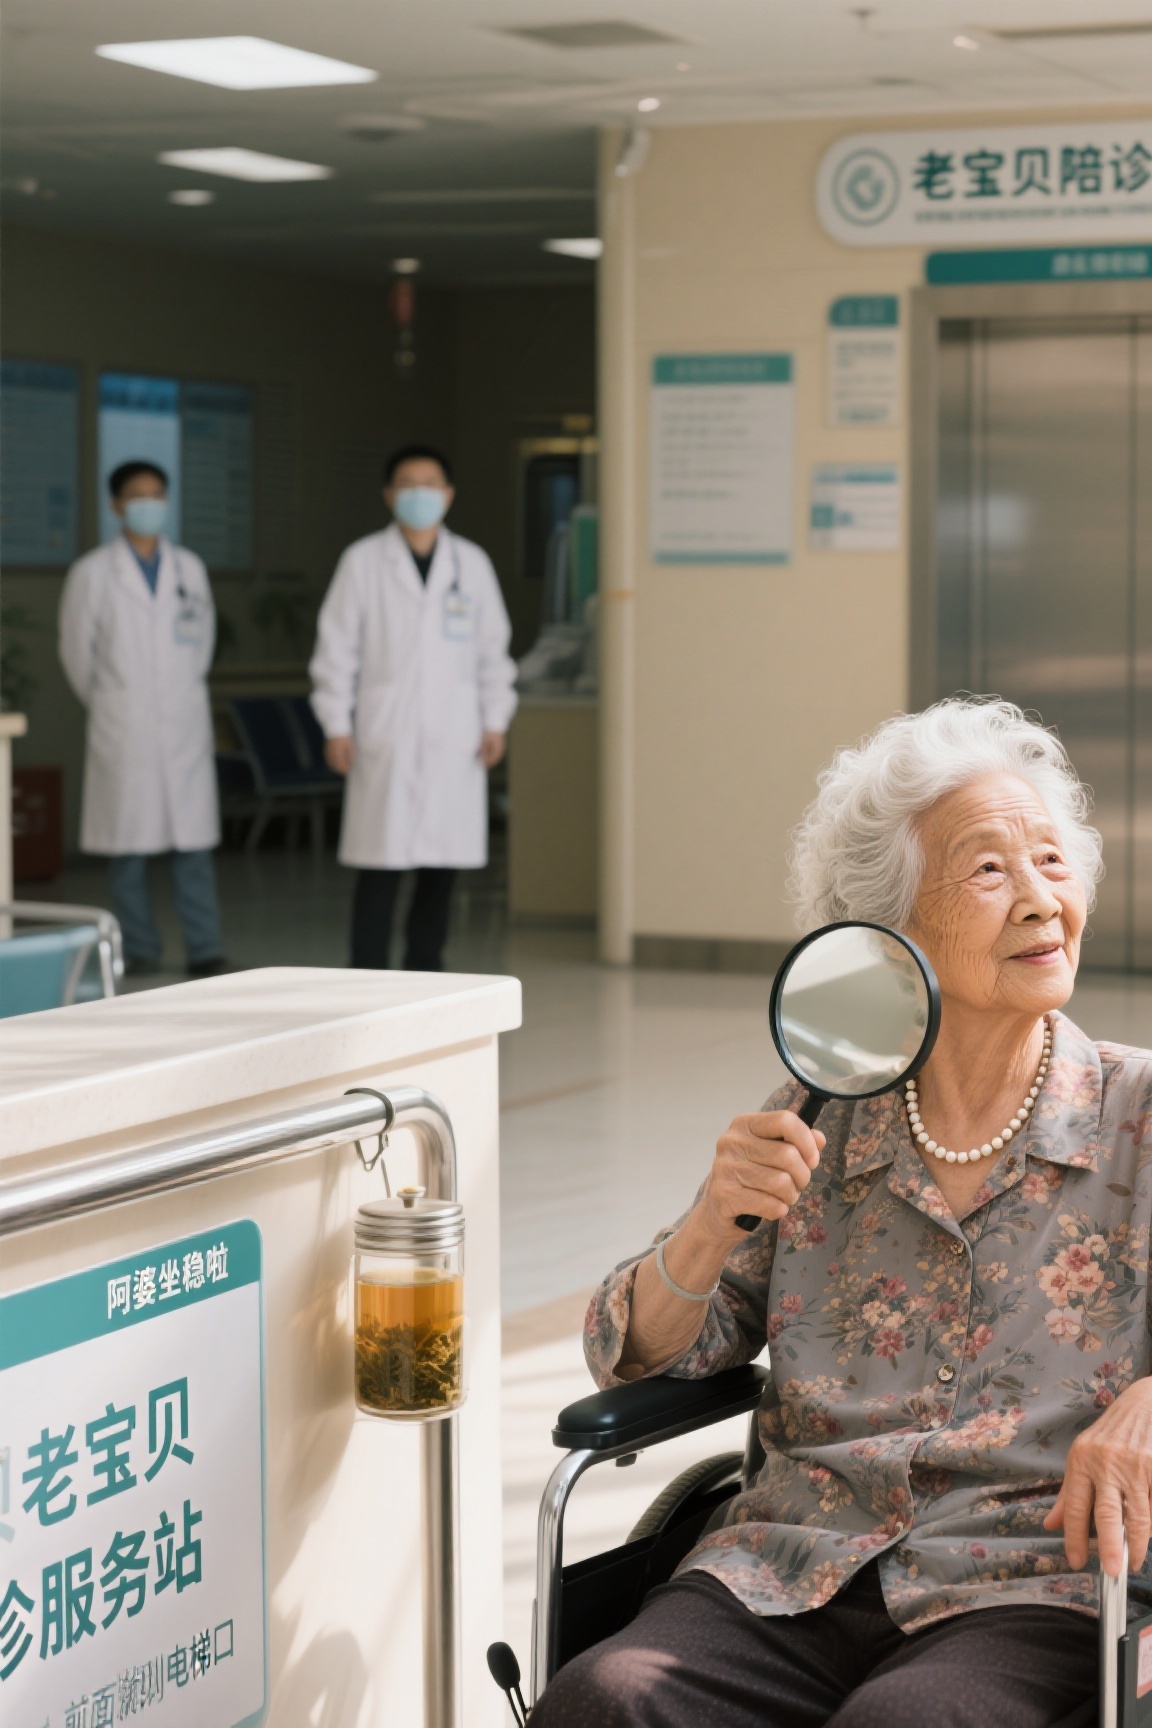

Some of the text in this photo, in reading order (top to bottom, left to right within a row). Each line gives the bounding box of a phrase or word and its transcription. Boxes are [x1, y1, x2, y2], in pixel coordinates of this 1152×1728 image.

[107, 1241, 229, 1320] 阿婆坐稳啦
